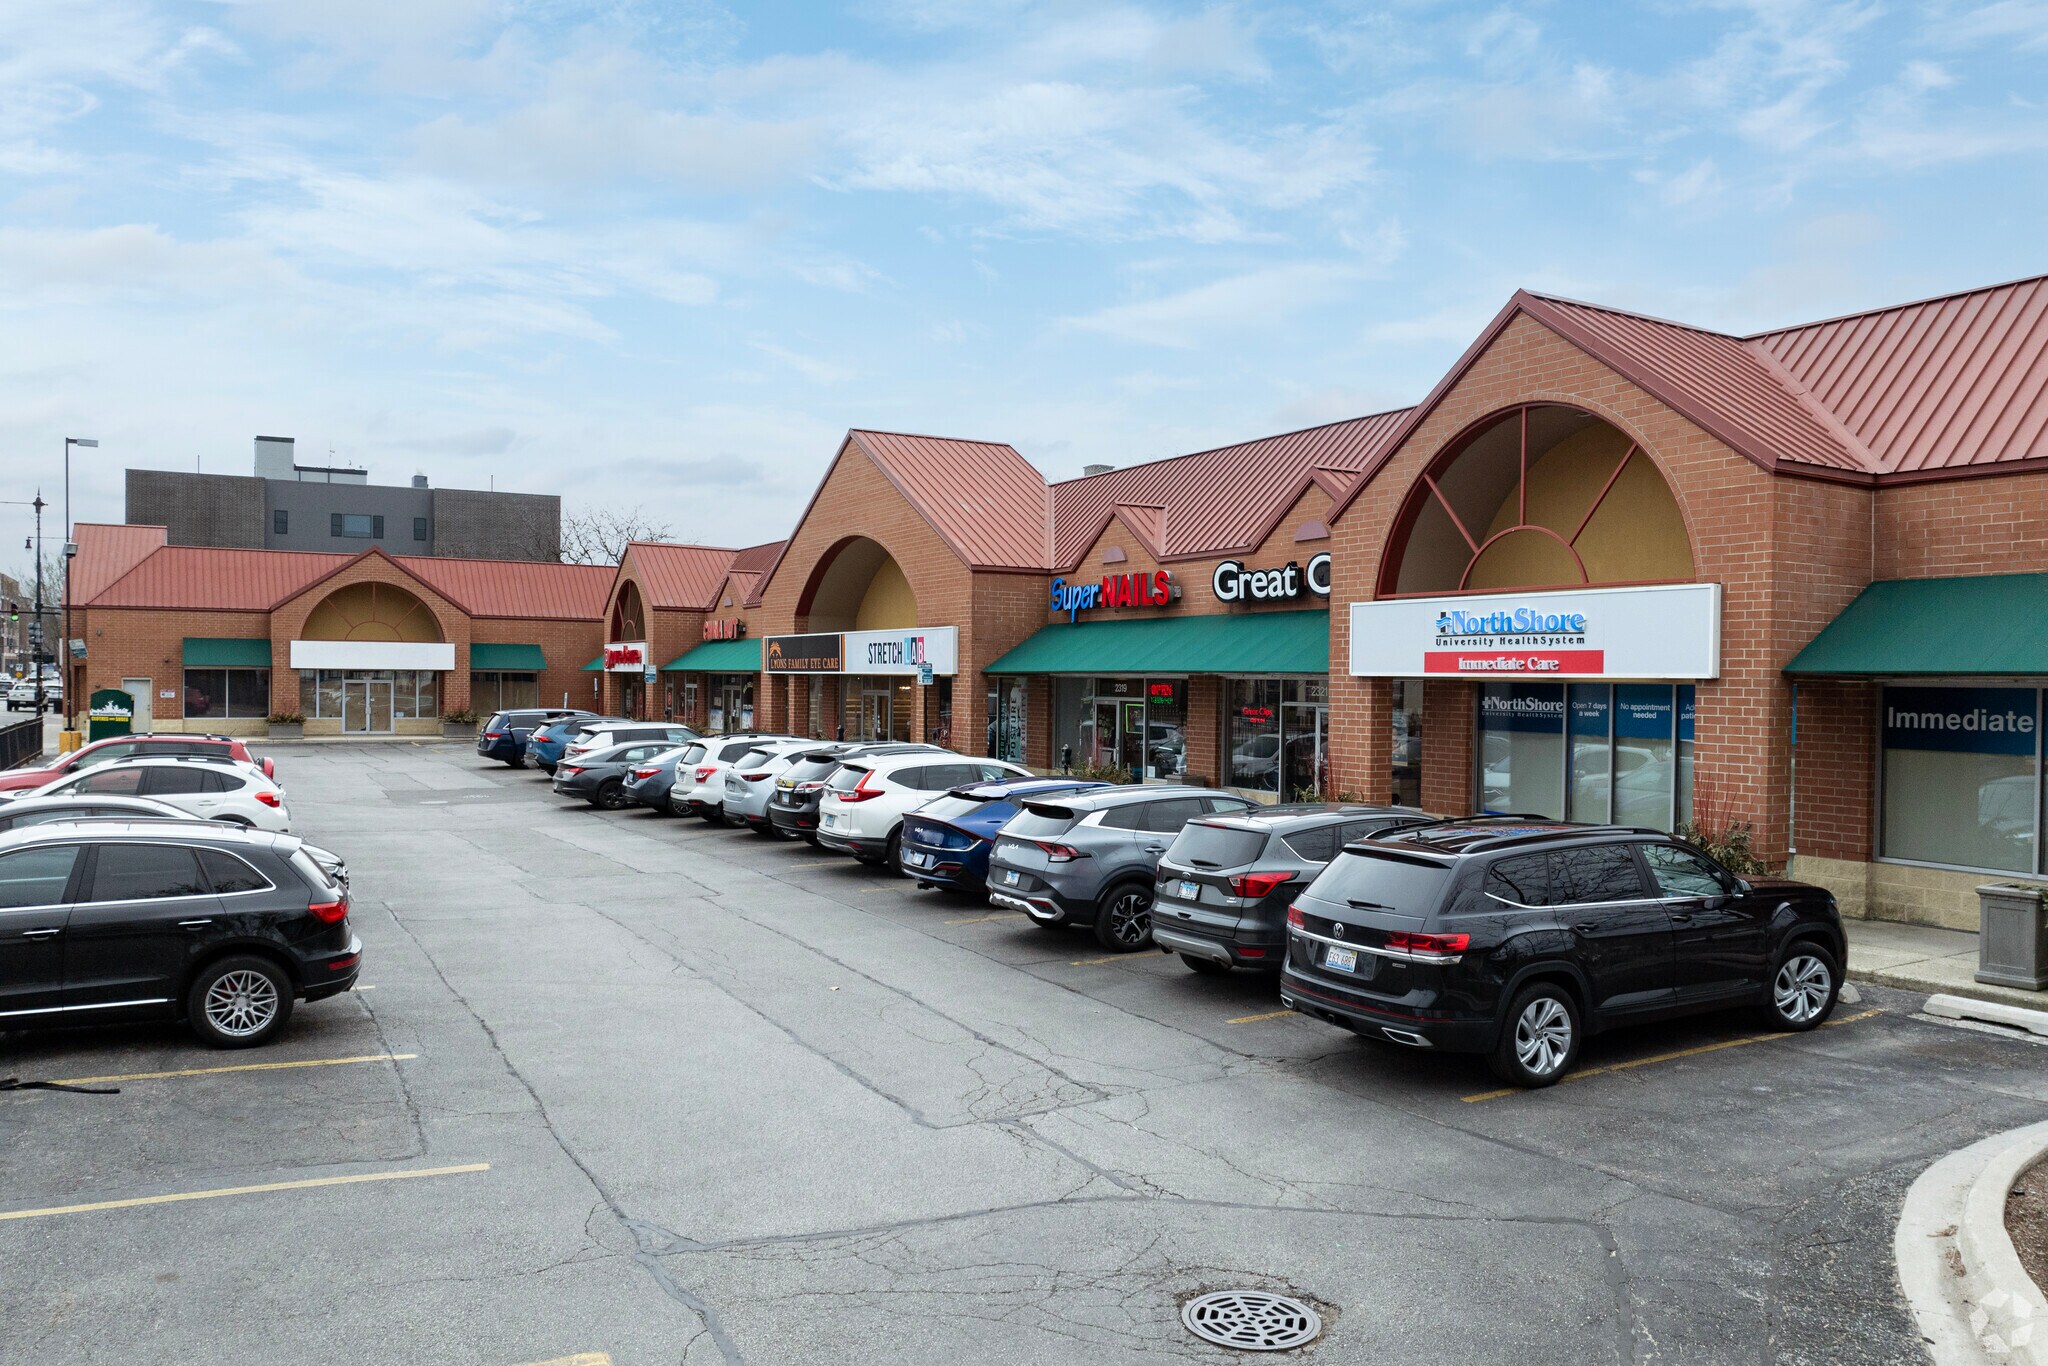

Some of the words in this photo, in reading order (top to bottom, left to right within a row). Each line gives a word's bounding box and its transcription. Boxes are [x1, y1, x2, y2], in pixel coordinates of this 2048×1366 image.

[1213, 560, 1297, 600] Great
[1051, 577, 1099, 623] Super
[1101, 569, 1170, 607] NAILS
[1450, 607, 1586, 634] NorthShore
[1436, 637, 1494, 647] University
[1499, 636, 1585, 646] HealthSystem
[770, 658, 787, 670] LYONS
[787, 657, 810, 669] FAMILY
[810, 658, 821, 669] EYE
[822, 657, 839, 669] CARE
[1458, 656, 1525, 671] Immediate
[1527, 656, 1559, 671] Care
[1114, 683, 1128, 693] 2319
[1311, 686, 1328, 697] 2321
[1491, 696, 1564, 711] NorthShore
[1572, 702, 1587, 710] Open
[1592, 702, 1607, 710] days
[1630, 703, 1671, 712] appointment
[1633, 711, 1657, 719] needed
[1888, 706, 2034, 733] Immediate
